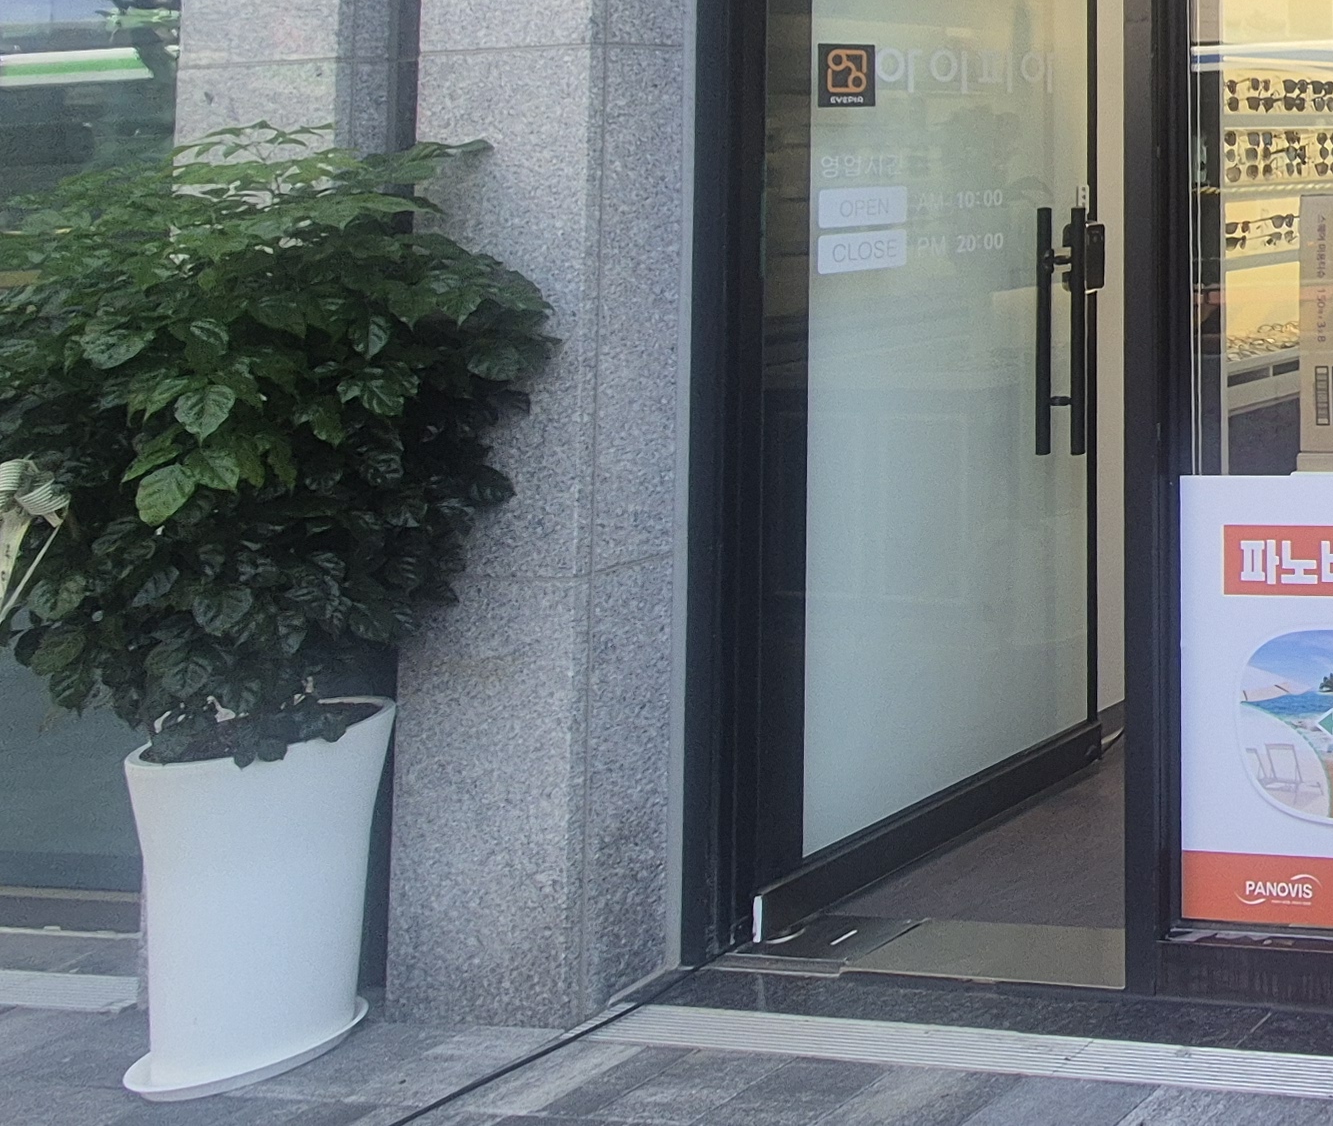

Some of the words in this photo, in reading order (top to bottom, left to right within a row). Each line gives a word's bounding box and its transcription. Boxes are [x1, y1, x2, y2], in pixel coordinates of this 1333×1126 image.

[876, 47, 1053, 93] 아이피아
[840, 198, 889, 217] OPEN
[957, 189, 1003, 208] 10:00
[832, 239, 897, 263] CLOSE
[957, 233, 1003, 253] 20:00
[1245, 881, 1313, 899] PANOVIS
